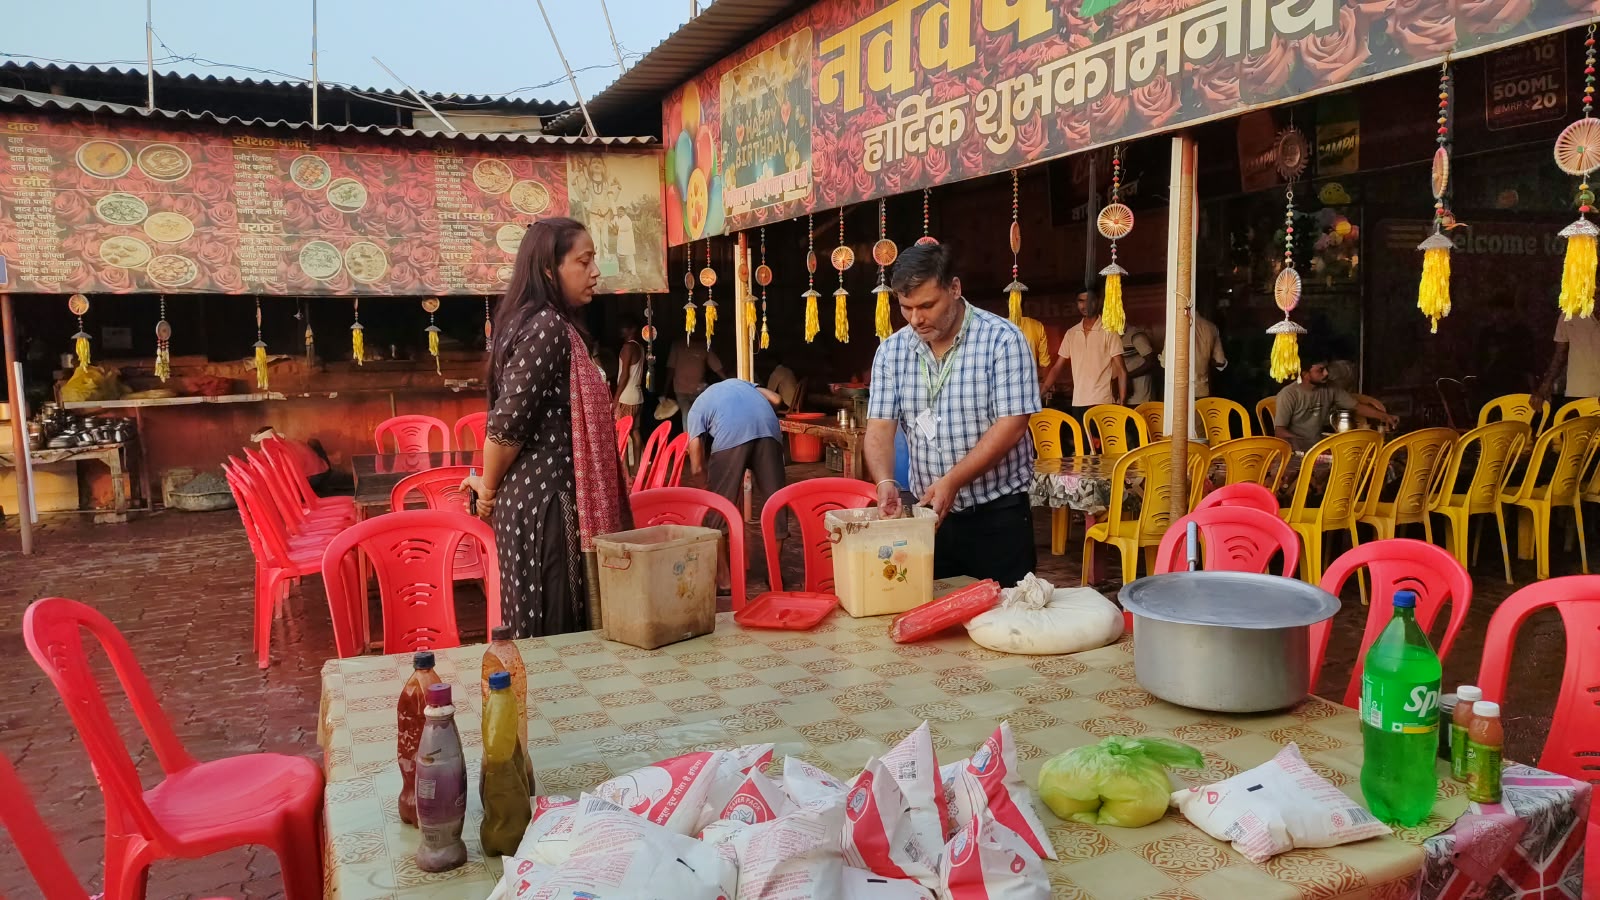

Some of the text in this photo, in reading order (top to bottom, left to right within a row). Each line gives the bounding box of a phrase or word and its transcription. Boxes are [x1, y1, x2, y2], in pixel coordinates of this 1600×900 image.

[1493, 75, 1560, 100] 500ML
[8, 122, 39, 132] दाल
[745, 105, 777, 135] HAPPY
[862, 88, 970, 172] हार्दिक
[735, 129, 789, 169] BIRTHDAY
[12, 176, 52, 188] पनीर
[1452, 230, 1537, 256] elcome
